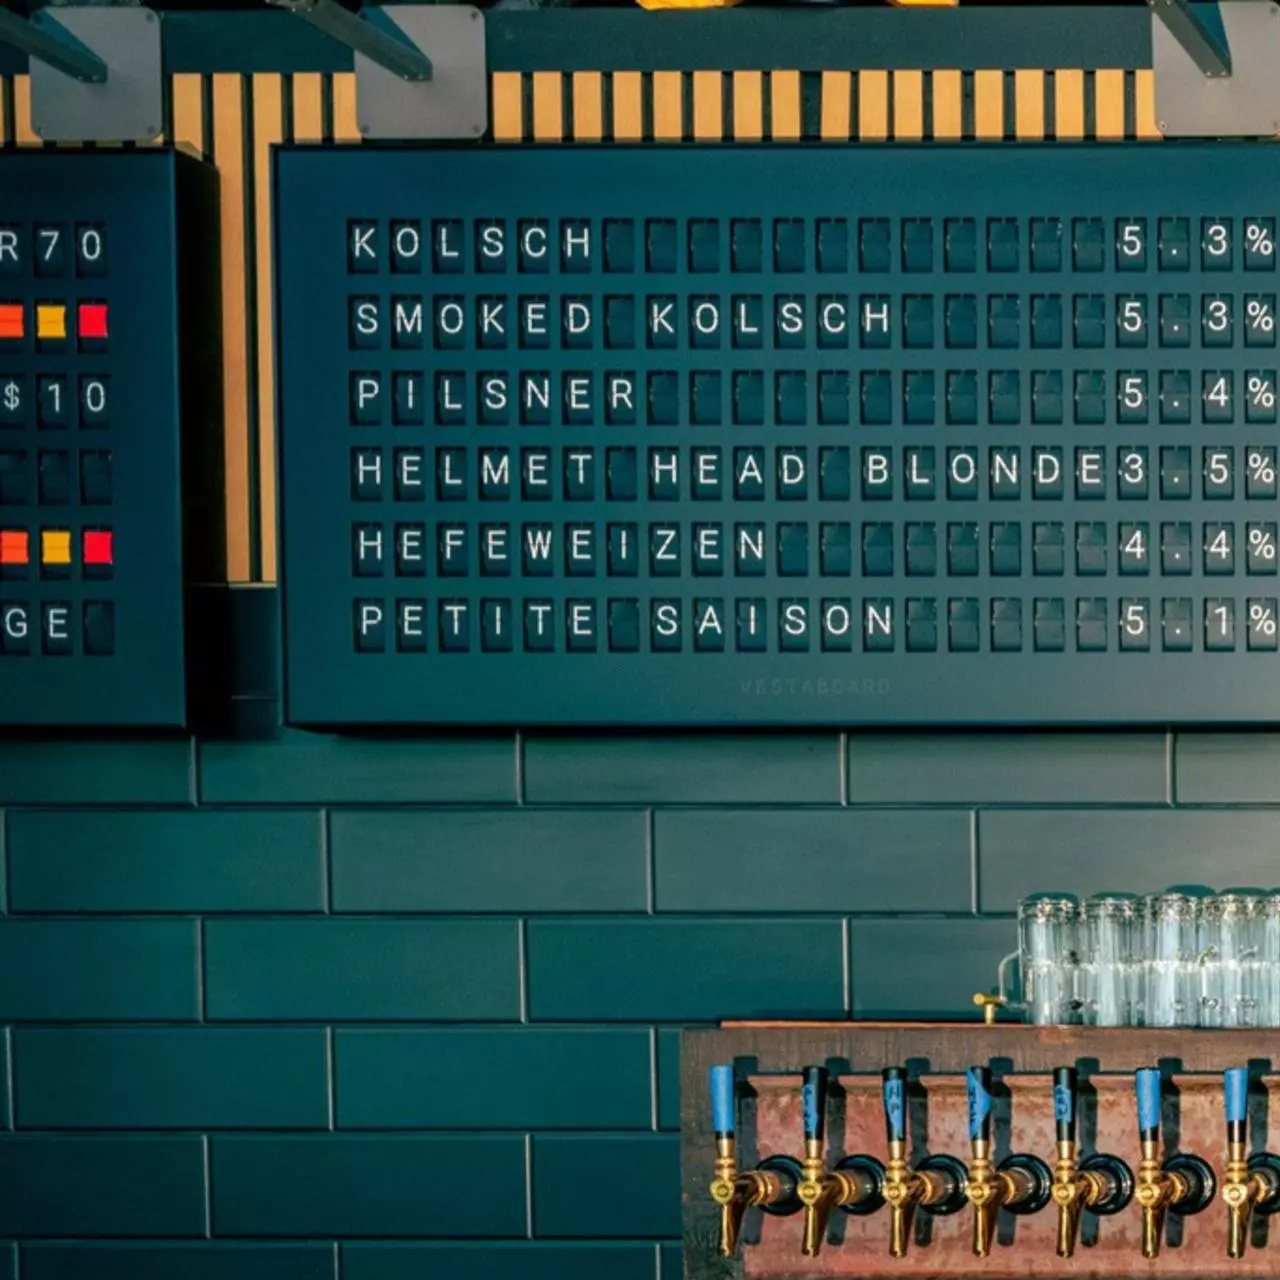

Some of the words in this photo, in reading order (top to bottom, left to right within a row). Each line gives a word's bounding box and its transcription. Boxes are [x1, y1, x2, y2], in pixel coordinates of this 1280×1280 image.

[354, 227, 589, 258] KOLSCH
[1123, 224, 1273, 256] 5.3%
[357, 303, 590, 334] SMOKED
[653, 302, 888, 333] KOLSCH
[1123, 301, 1273, 332] 5.3%
[4, 382, 105, 412] $10
[359, 379, 633, 409] PILSNER
[1124, 377, 1274, 408] 5.4%
[358, 454, 592, 485] HELMET
[654, 454, 804, 484] HEAD
[360, 529, 763, 560] HEFEWEIZEN
[1124, 529, 1275, 560] 4.4%
[5, 608, 68, 638] GE
[362, 605, 592, 635] PETITE
[656, 605, 891, 635] SAISON
[1126, 604, 1276, 636] 5.1%
